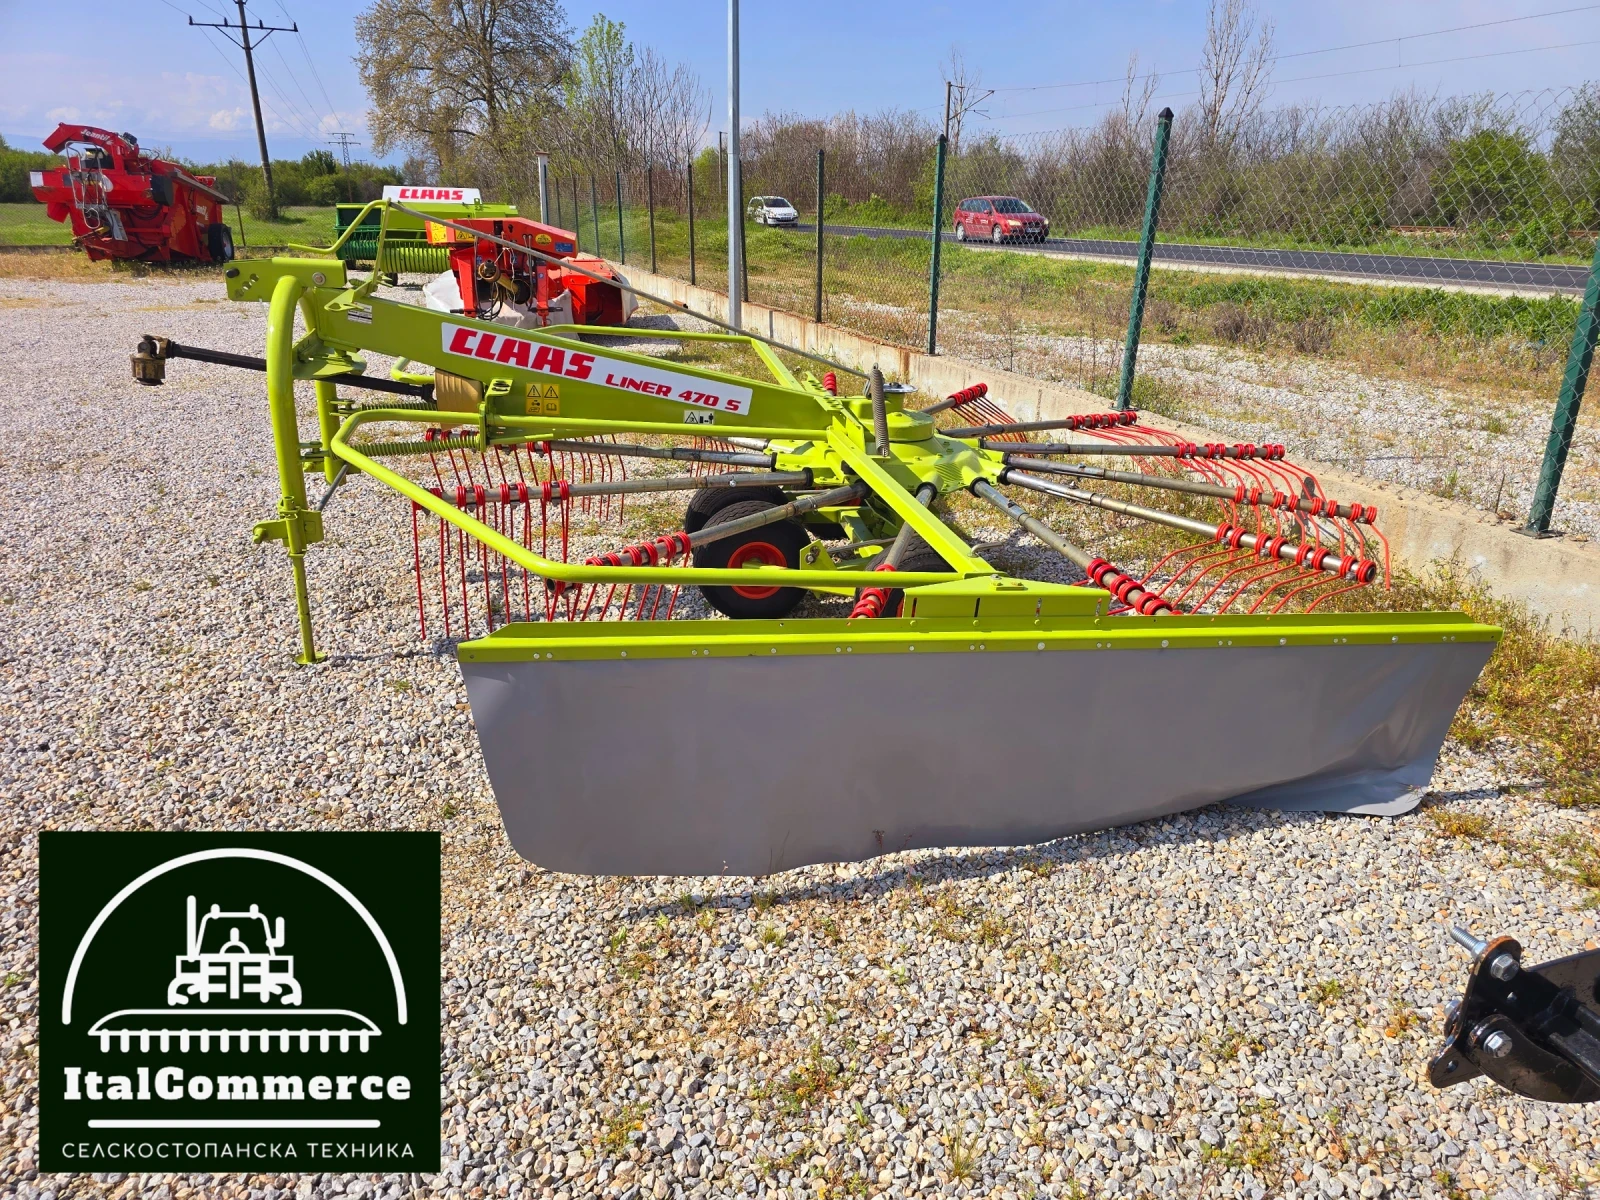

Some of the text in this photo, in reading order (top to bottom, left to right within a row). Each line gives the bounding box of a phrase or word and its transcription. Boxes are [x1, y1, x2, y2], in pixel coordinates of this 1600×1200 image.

[399, 188, 464, 201] CLAAS
[449, 327, 741, 412] CLAAS LINER 470 S
